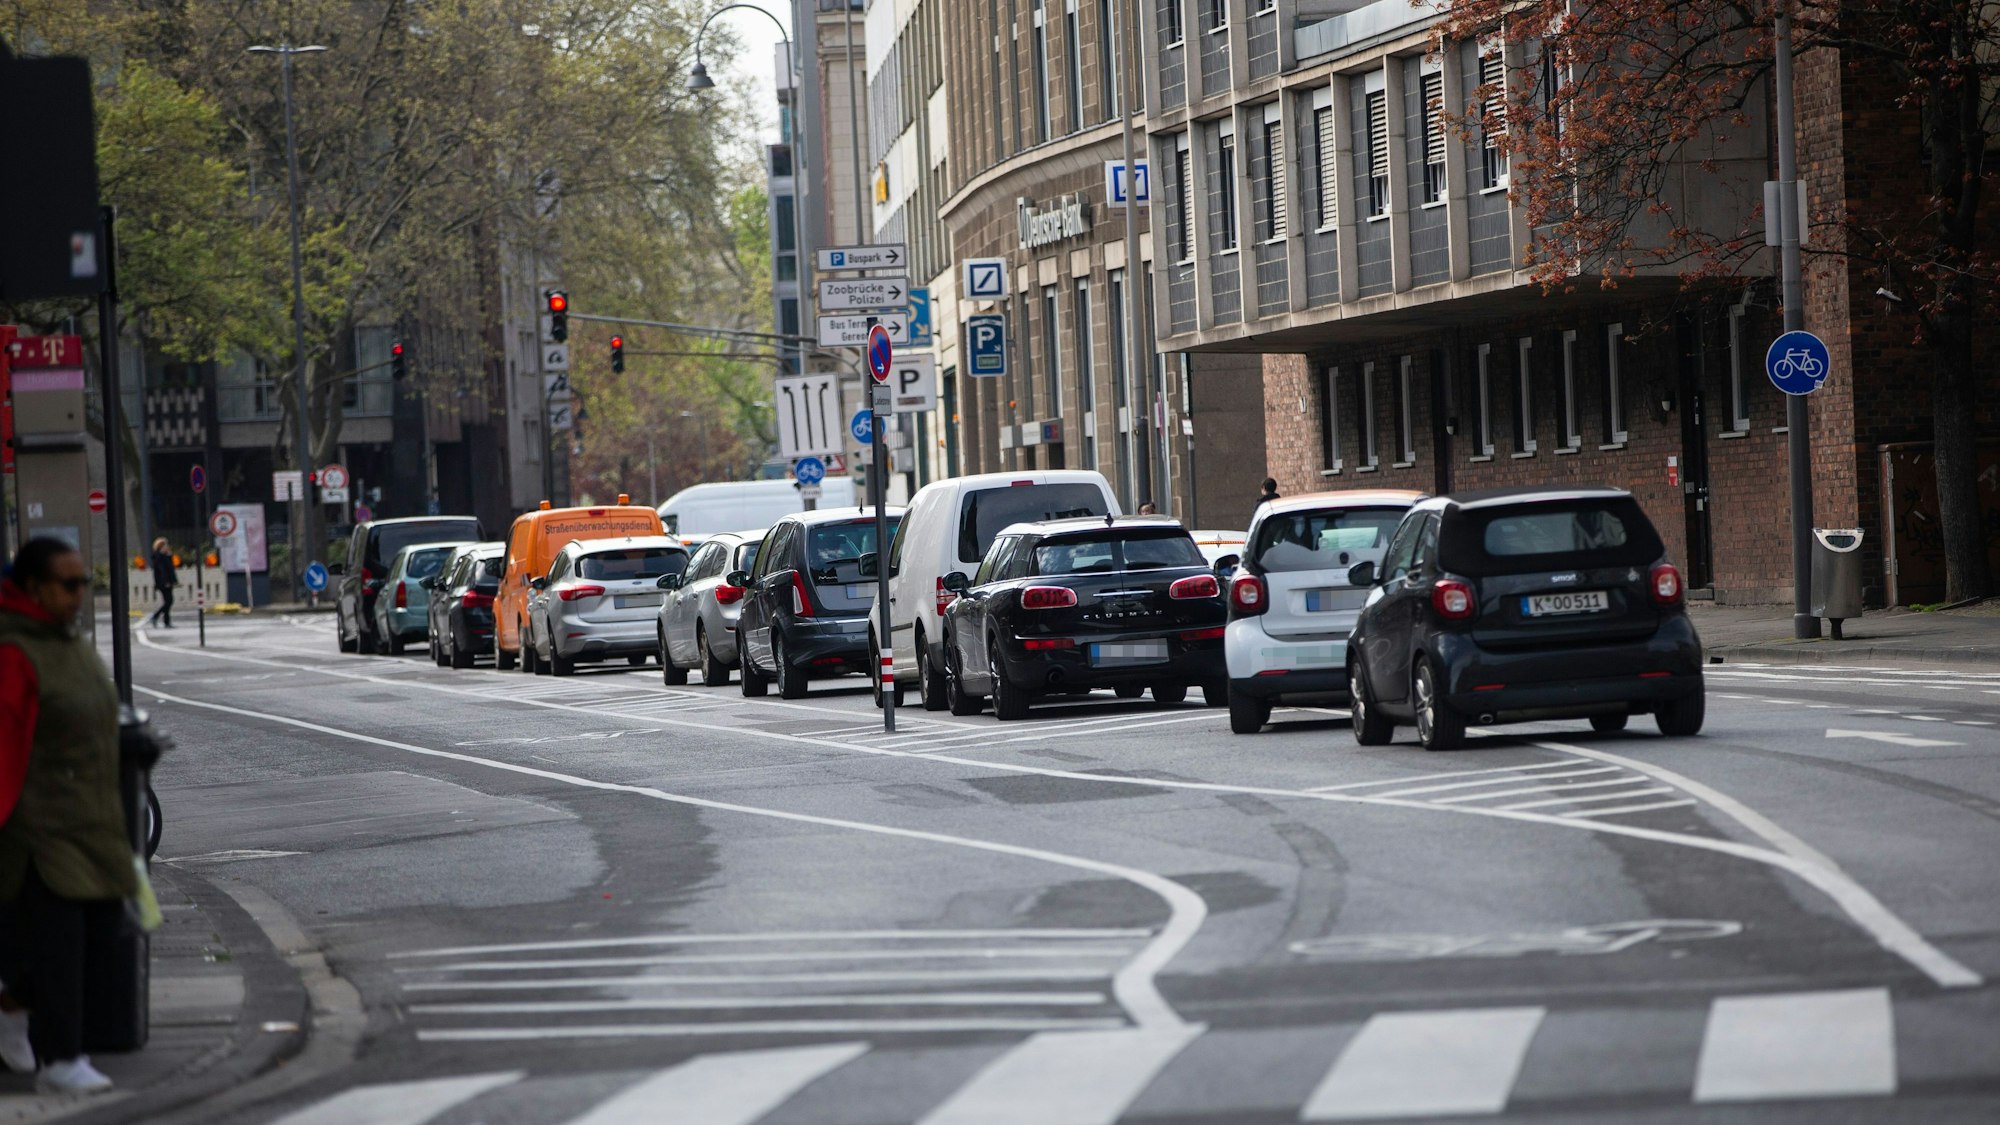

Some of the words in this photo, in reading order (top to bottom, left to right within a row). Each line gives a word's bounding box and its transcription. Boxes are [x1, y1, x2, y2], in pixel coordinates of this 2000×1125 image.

[1062, 191, 1083, 238] Bank
[833, 253, 842, 264] P
[848, 253, 881, 265] Buspark
[827, 284, 884, 296] Zoobrücke
[849, 294, 885, 304] Polizei
[830, 320, 846, 330] Bus
[977, 327, 995, 349] P
[43, 338, 64, 365] T
[899, 369, 919, 394] P
[545, 520, 653, 534] Straßenüberwachungsdienst
[1551, 574, 1576, 583] smart
